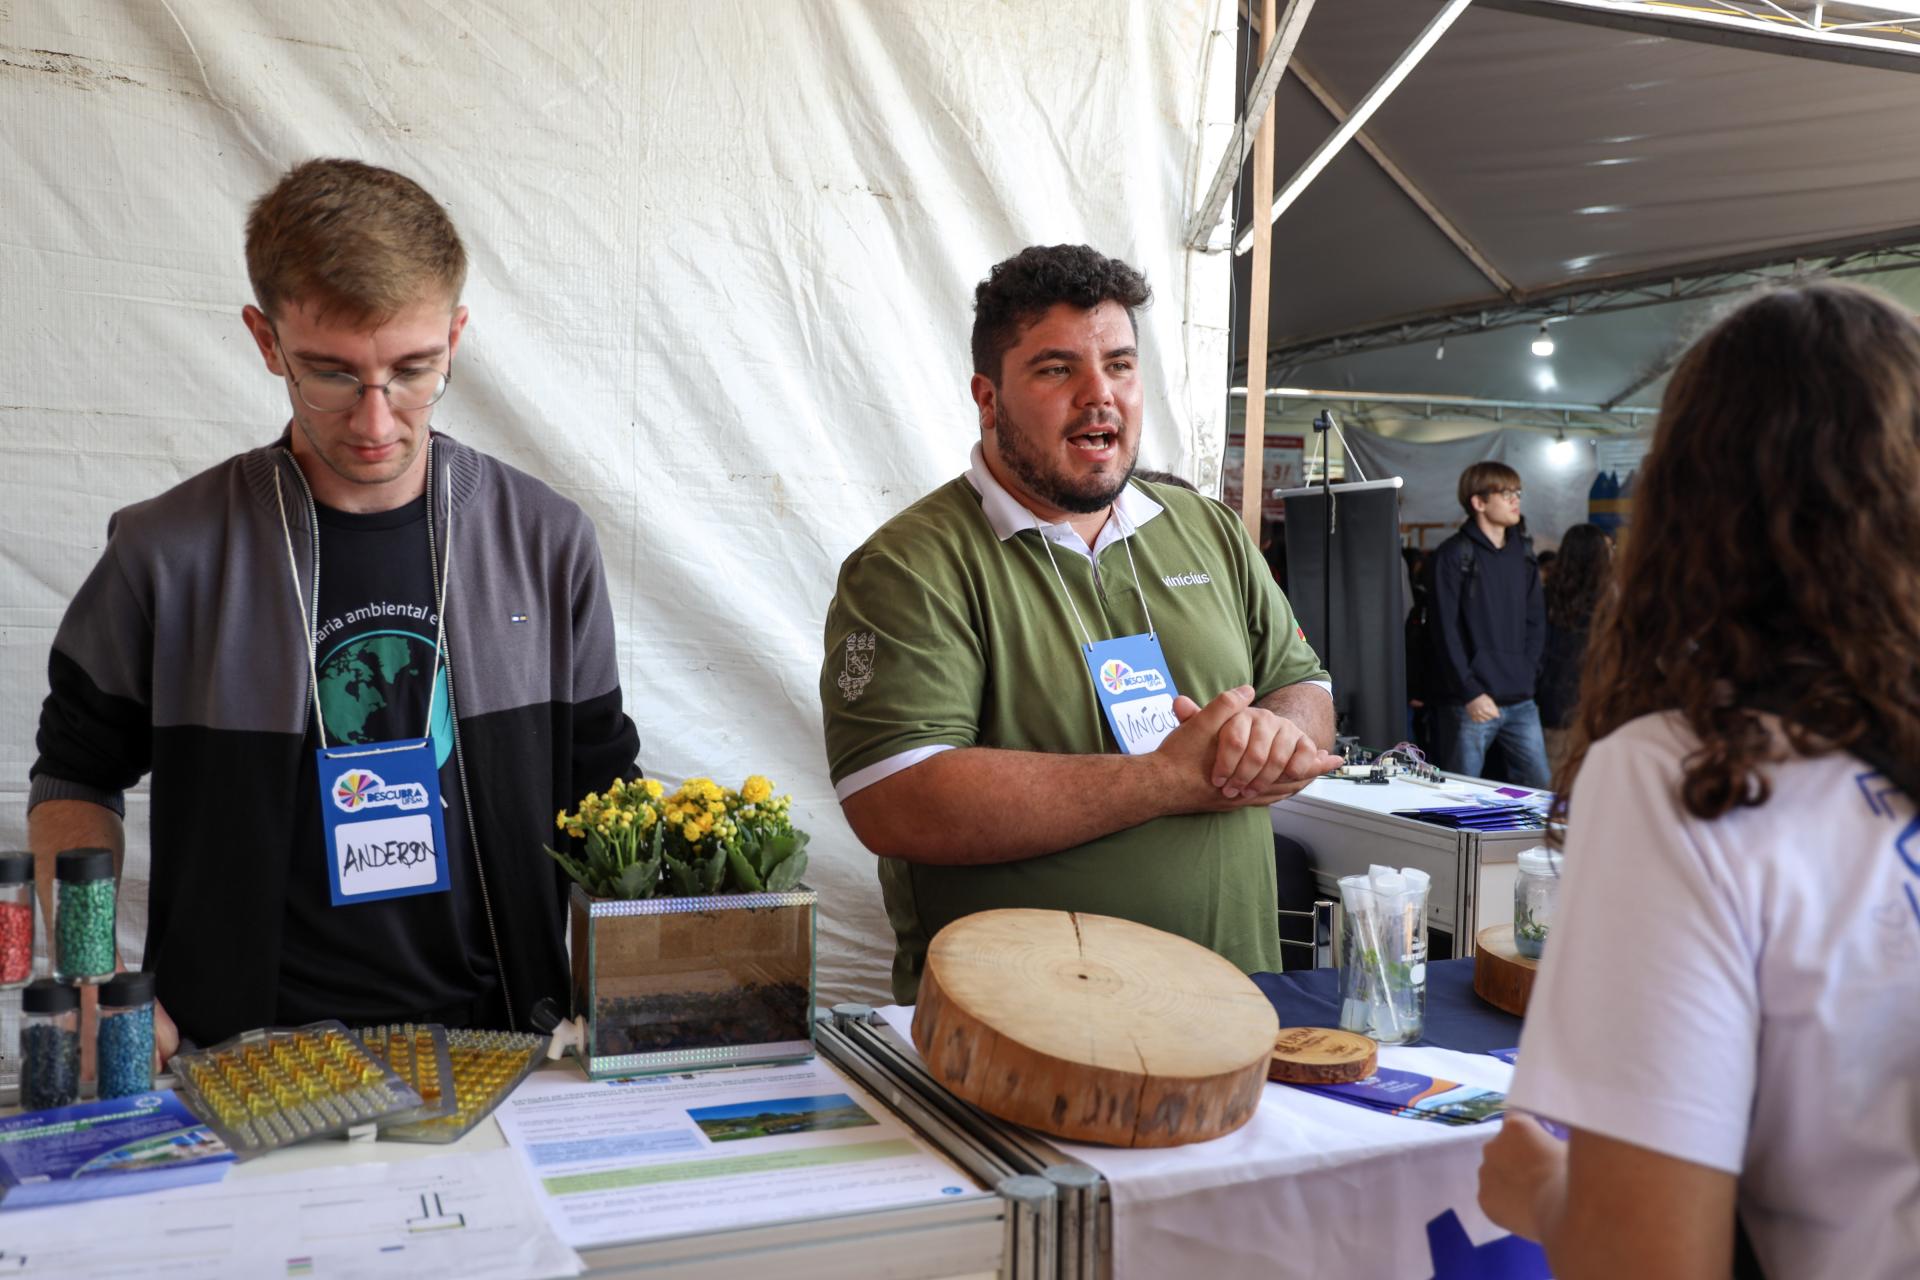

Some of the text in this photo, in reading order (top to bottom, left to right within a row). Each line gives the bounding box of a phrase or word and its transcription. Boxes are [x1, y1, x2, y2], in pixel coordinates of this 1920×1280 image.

[344, 601, 429, 624] ambiental
[429, 614, 439, 626] e
[366, 788, 423, 803] DESCUBRA
